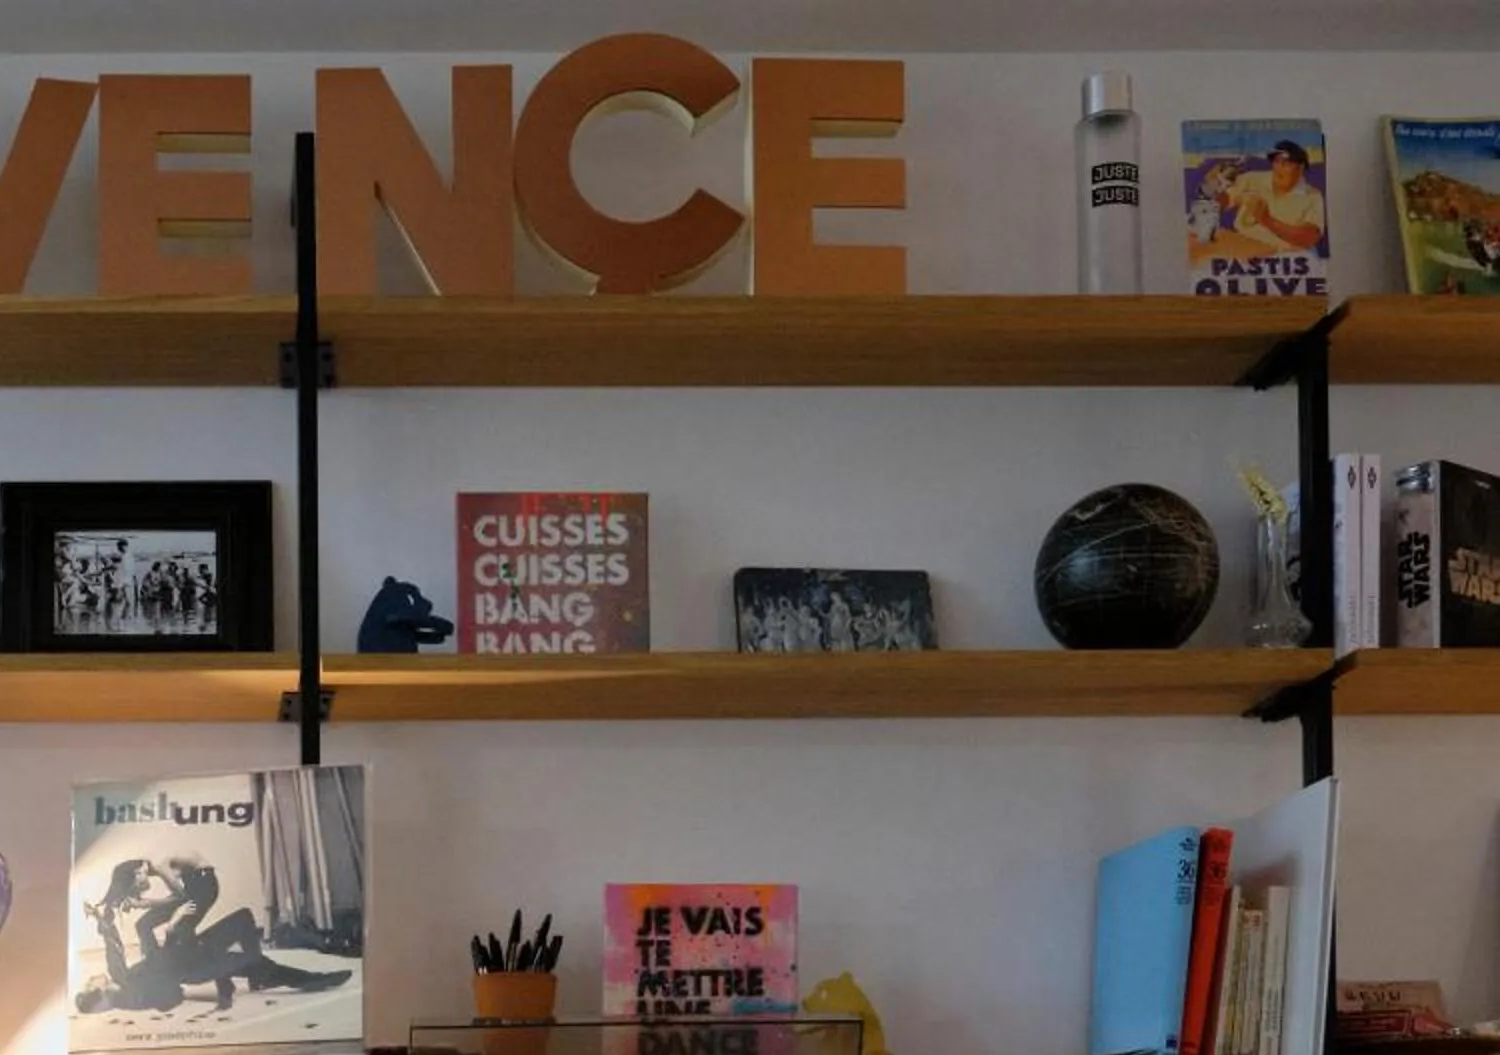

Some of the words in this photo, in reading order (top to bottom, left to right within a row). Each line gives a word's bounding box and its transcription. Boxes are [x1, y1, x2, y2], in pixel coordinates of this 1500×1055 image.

[1211, 257, 1310, 276] PASTIS
[473, 513, 630, 547] CUISSES
[474, 553, 630, 587] CUISSES
[1413, 531, 1431, 608] WARS
[475, 592, 595, 627] BANG
[476, 629, 597, 654] BANG
[637, 907, 671, 936] JE
[680, 907, 764, 936] VAIS
[635, 939, 671, 967] TE
[637, 967, 765, 997] METTRE
